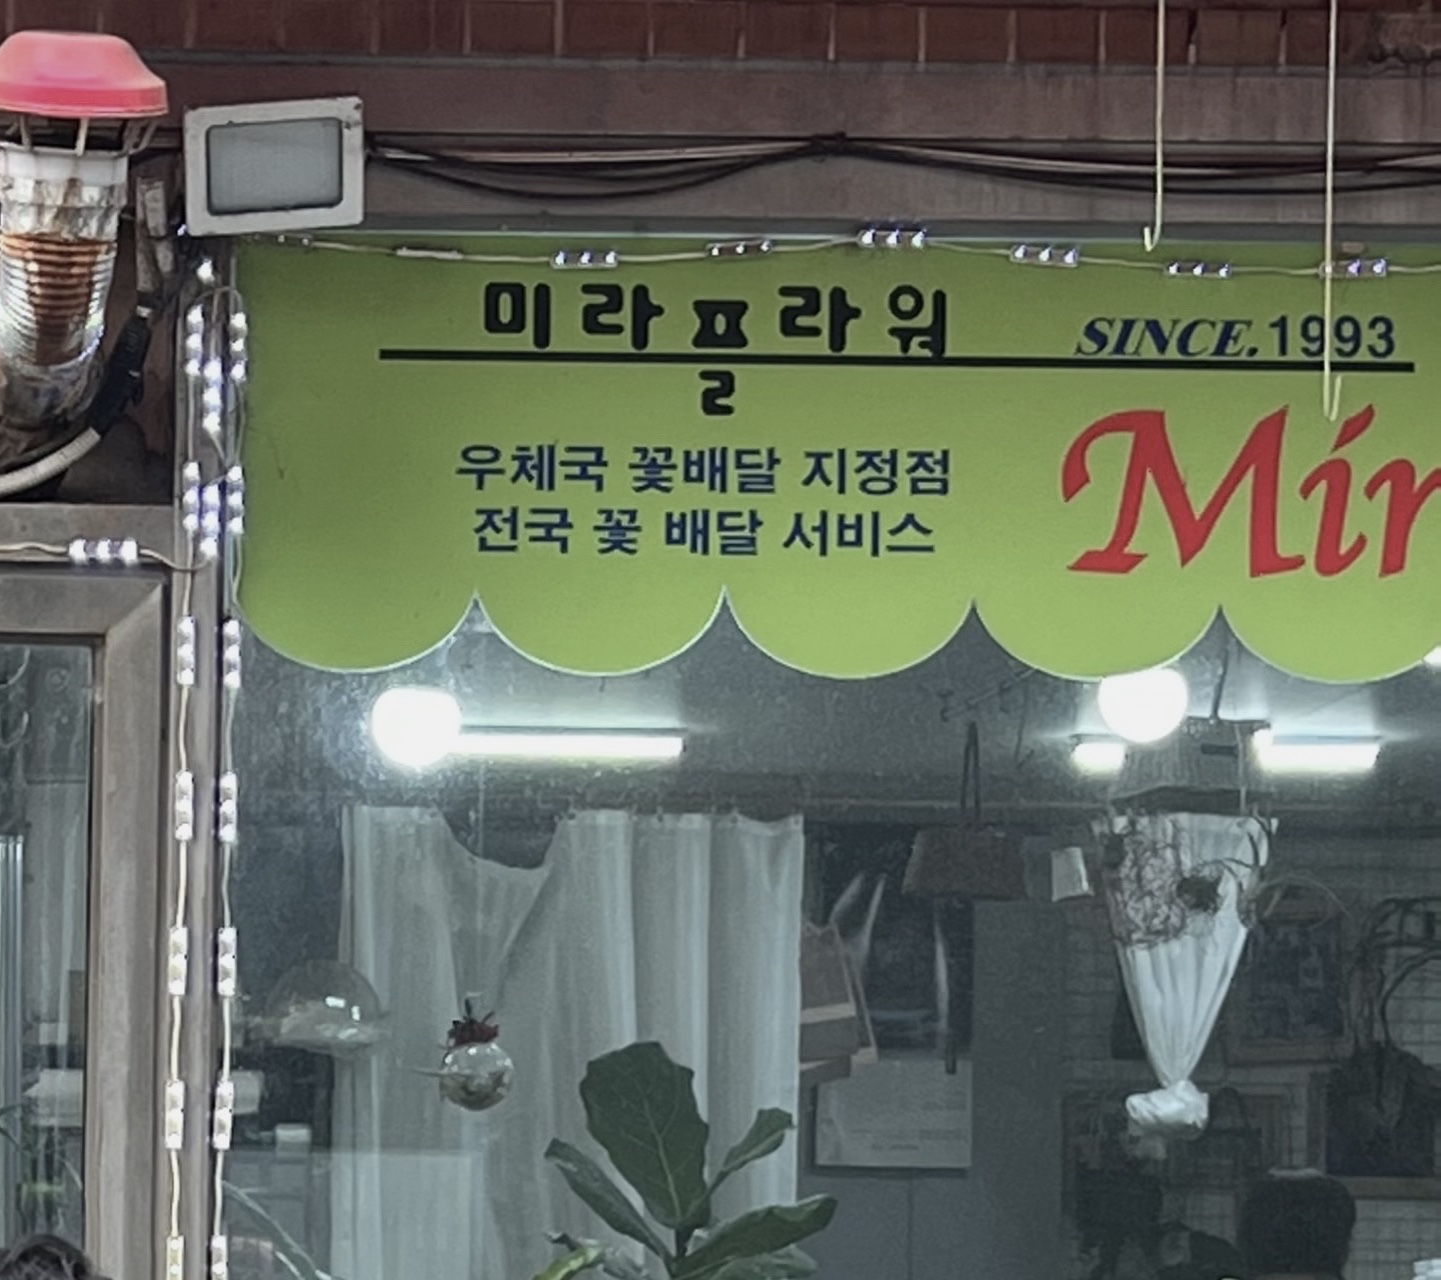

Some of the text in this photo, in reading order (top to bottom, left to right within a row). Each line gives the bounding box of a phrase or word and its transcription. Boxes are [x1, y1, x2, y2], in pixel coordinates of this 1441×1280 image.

[455, 443, 951, 496] 우체국 꽃배달 지정점
[472, 505, 936, 558] 전국 꽃 배달 서비스
